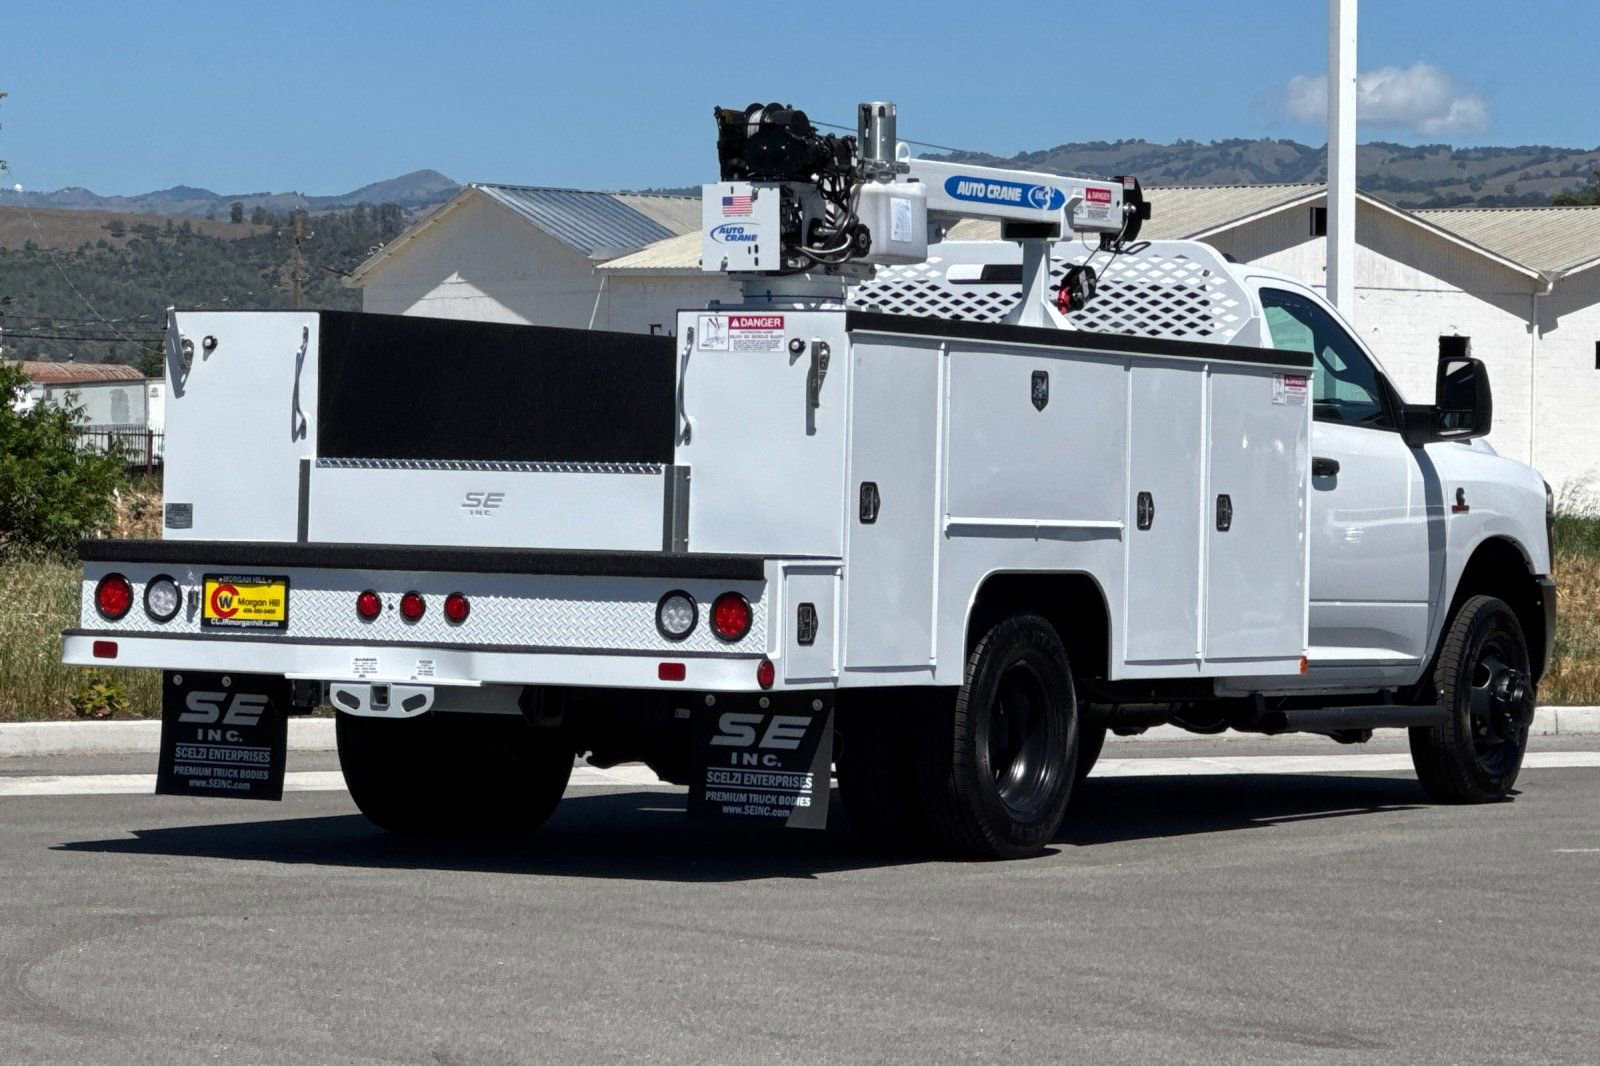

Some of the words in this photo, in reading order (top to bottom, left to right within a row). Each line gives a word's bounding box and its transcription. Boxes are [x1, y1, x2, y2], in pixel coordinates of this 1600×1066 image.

[957, 181, 985, 198] AUTO
[987, 184, 1022, 201] CRANE
[725, 234, 758, 242] CRANE
[740, 318, 781, 327] DANGER
[461, 492, 505, 508] SE
[223, 576, 251, 584] MORGAN
[238, 598, 267, 607] Morgan
[178, 690, 269, 726] SE
[197, 728, 243, 743] INC.
[709, 712, 813, 750] SE
[175, 746, 207, 759] SCELZI
[208, 748, 271, 763] ENTERPRISES
[731, 752, 782, 767] INC.
[173, 765, 212, 777] PREMIUM
[212, 767, 239, 778] TRUCK
[239, 769, 269, 780] BODIES
[706, 771, 742, 784] SCELZI
[743, 773, 813, 789] ENTERPRISES
[189, 779, 251, 790] www.SEINC.com
[705, 791, 747, 803] PREMIUM
[748, 793, 778, 805] TRUCK
[778, 795, 811, 807] BODIES
[722, 805, 791, 817] www.SEINC.com
